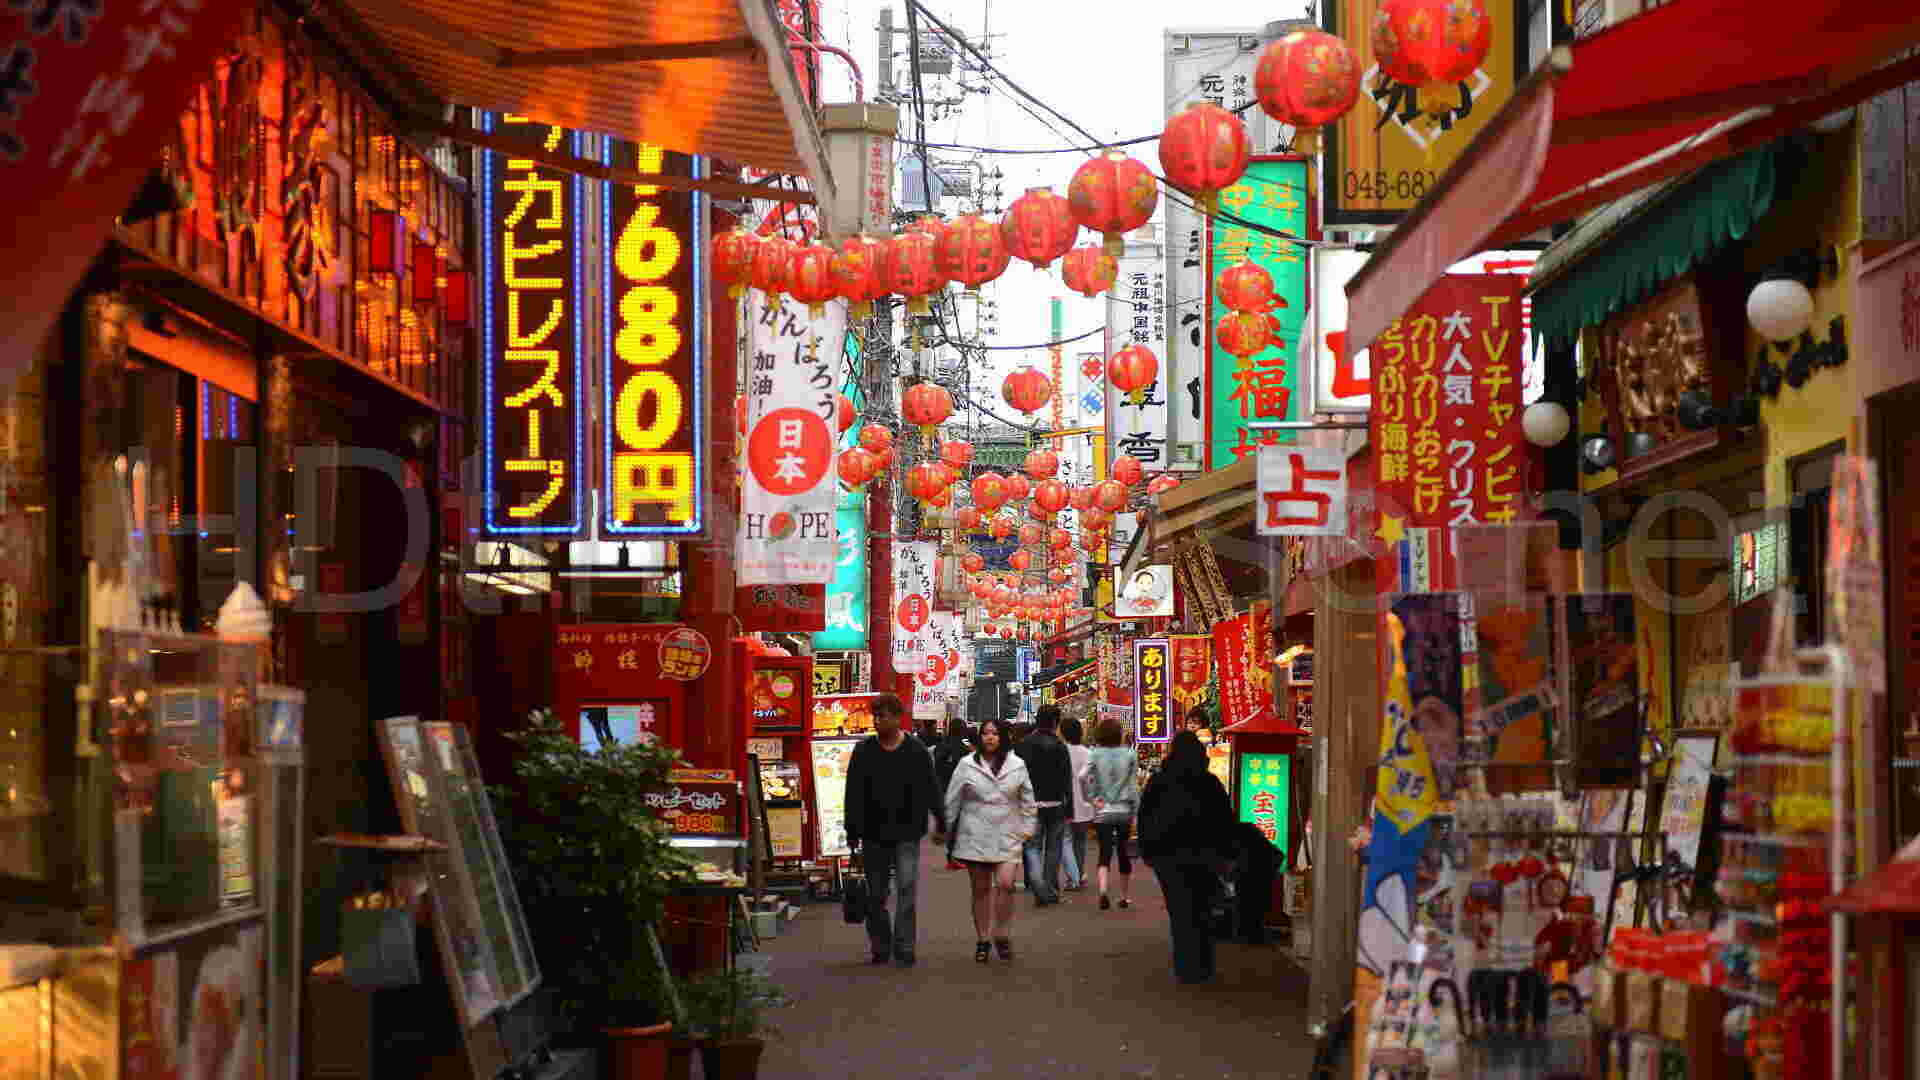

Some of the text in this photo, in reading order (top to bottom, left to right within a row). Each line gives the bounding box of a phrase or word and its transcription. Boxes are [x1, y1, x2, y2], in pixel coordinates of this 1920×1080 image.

[752, 351, 776, 417] 加油！
[758, 298, 836, 420] がんばろう
[773, 418, 806, 485] 日本
[745, 511, 830, 539] HOPE
[1263, 453, 1341, 528] 占
[1141, 648, 1164, 735] あります
